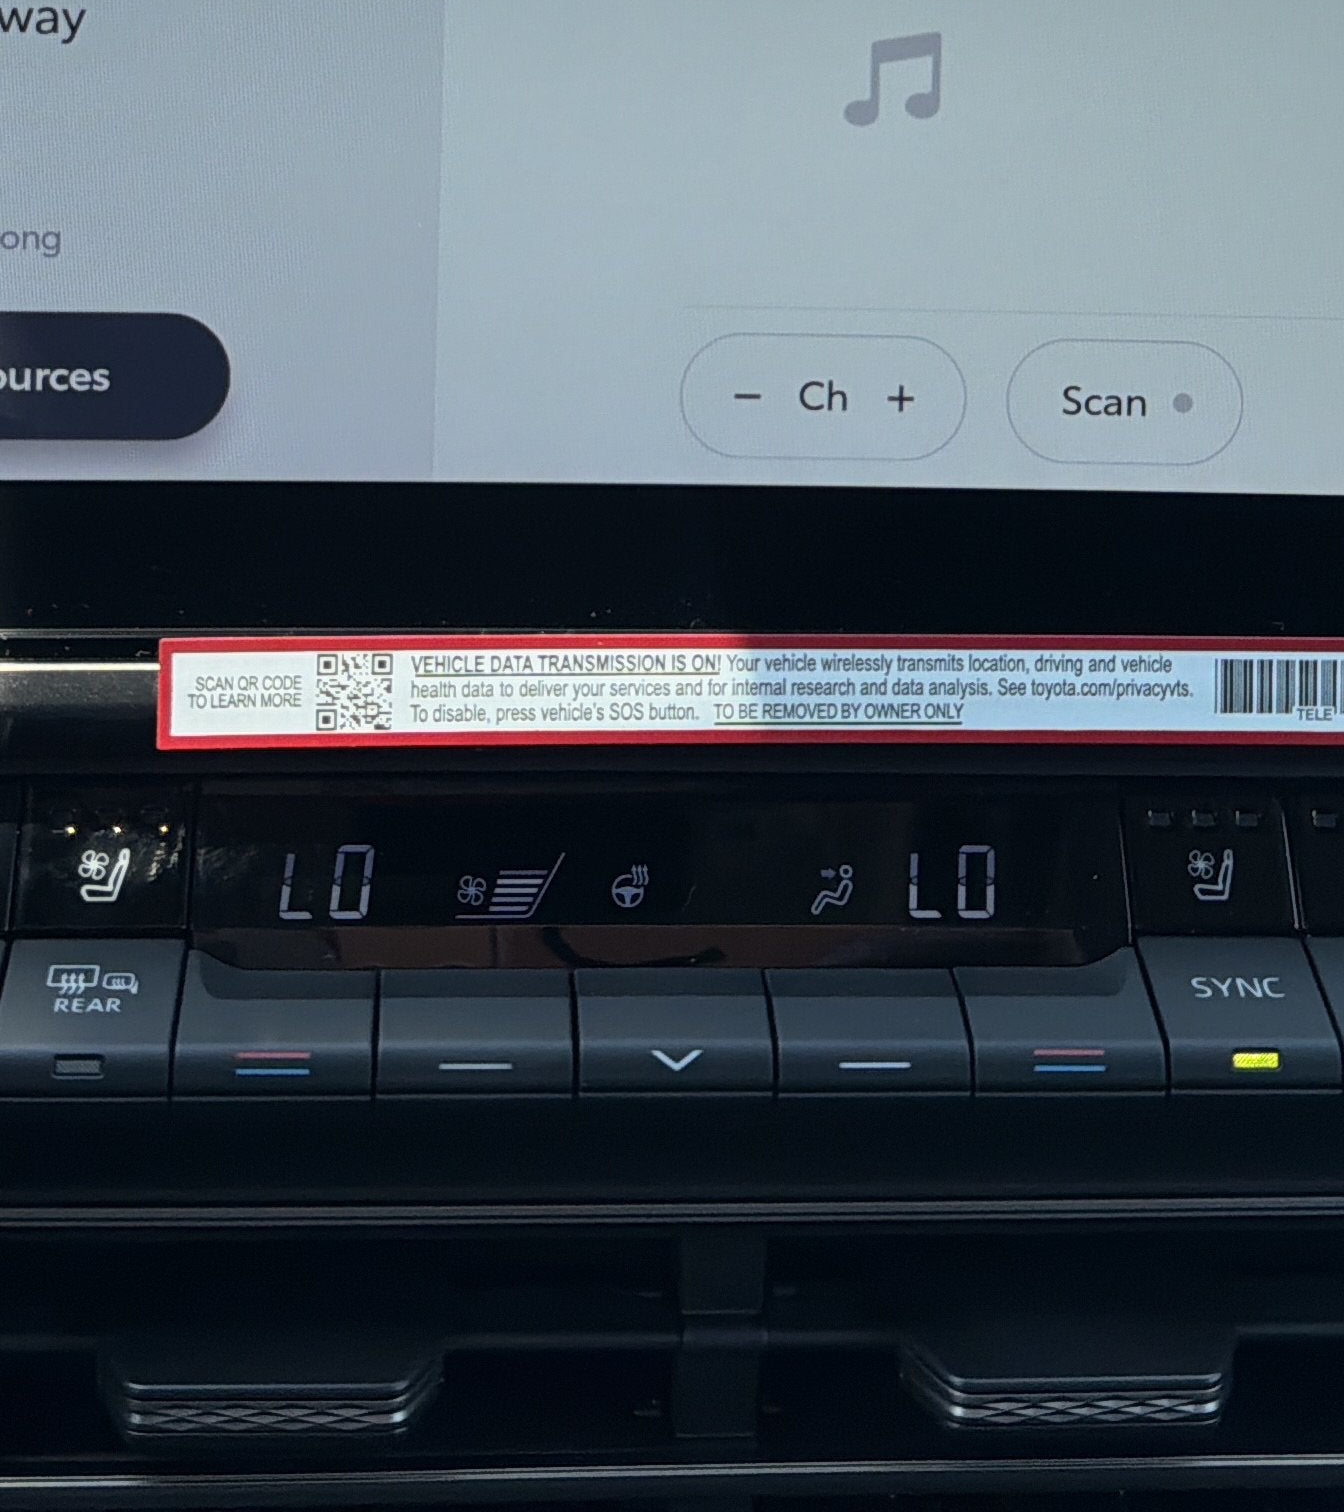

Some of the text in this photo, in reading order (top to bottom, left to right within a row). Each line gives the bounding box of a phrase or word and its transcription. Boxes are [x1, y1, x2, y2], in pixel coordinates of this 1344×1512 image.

[798, 380, 848, 411] Ch
[1061, 385, 1147, 417] Scan
[411, 653, 1173, 677] VEHICLE DATA TRANSMISSION IS ON! Your vehicle wirelessly transmits location, driving and vehicle
[194, 675, 303, 692] SCAN QR CODE
[411, 679, 457, 698] health
[461, 679, 495, 698] data
[499, 681, 514, 697] to
[519, 680, 569, 697] deliver
[572, 684, 606, 701] your
[609, 680, 671, 697] services
[674, 679, 704, 697] and
[707, 678, 727, 697] for
[731, 678, 787, 696] internal
[791, 678, 856, 696] research
[860, 678, 888, 696] and
[892, 678, 925, 696] data
[928, 678, 993, 700] analysis.
[997, 678, 1027, 696] See
[187, 693, 303, 709] TO LEARN MORE
[411, 702, 964, 726] To disable, press vehicle's SOS button. TO BE REMOVED BY OWNER ONLY
[1297, 708, 1332, 721] TELE
[1191, 976, 1286, 999] SYNC
[54, 996, 122, 1013] REAR
